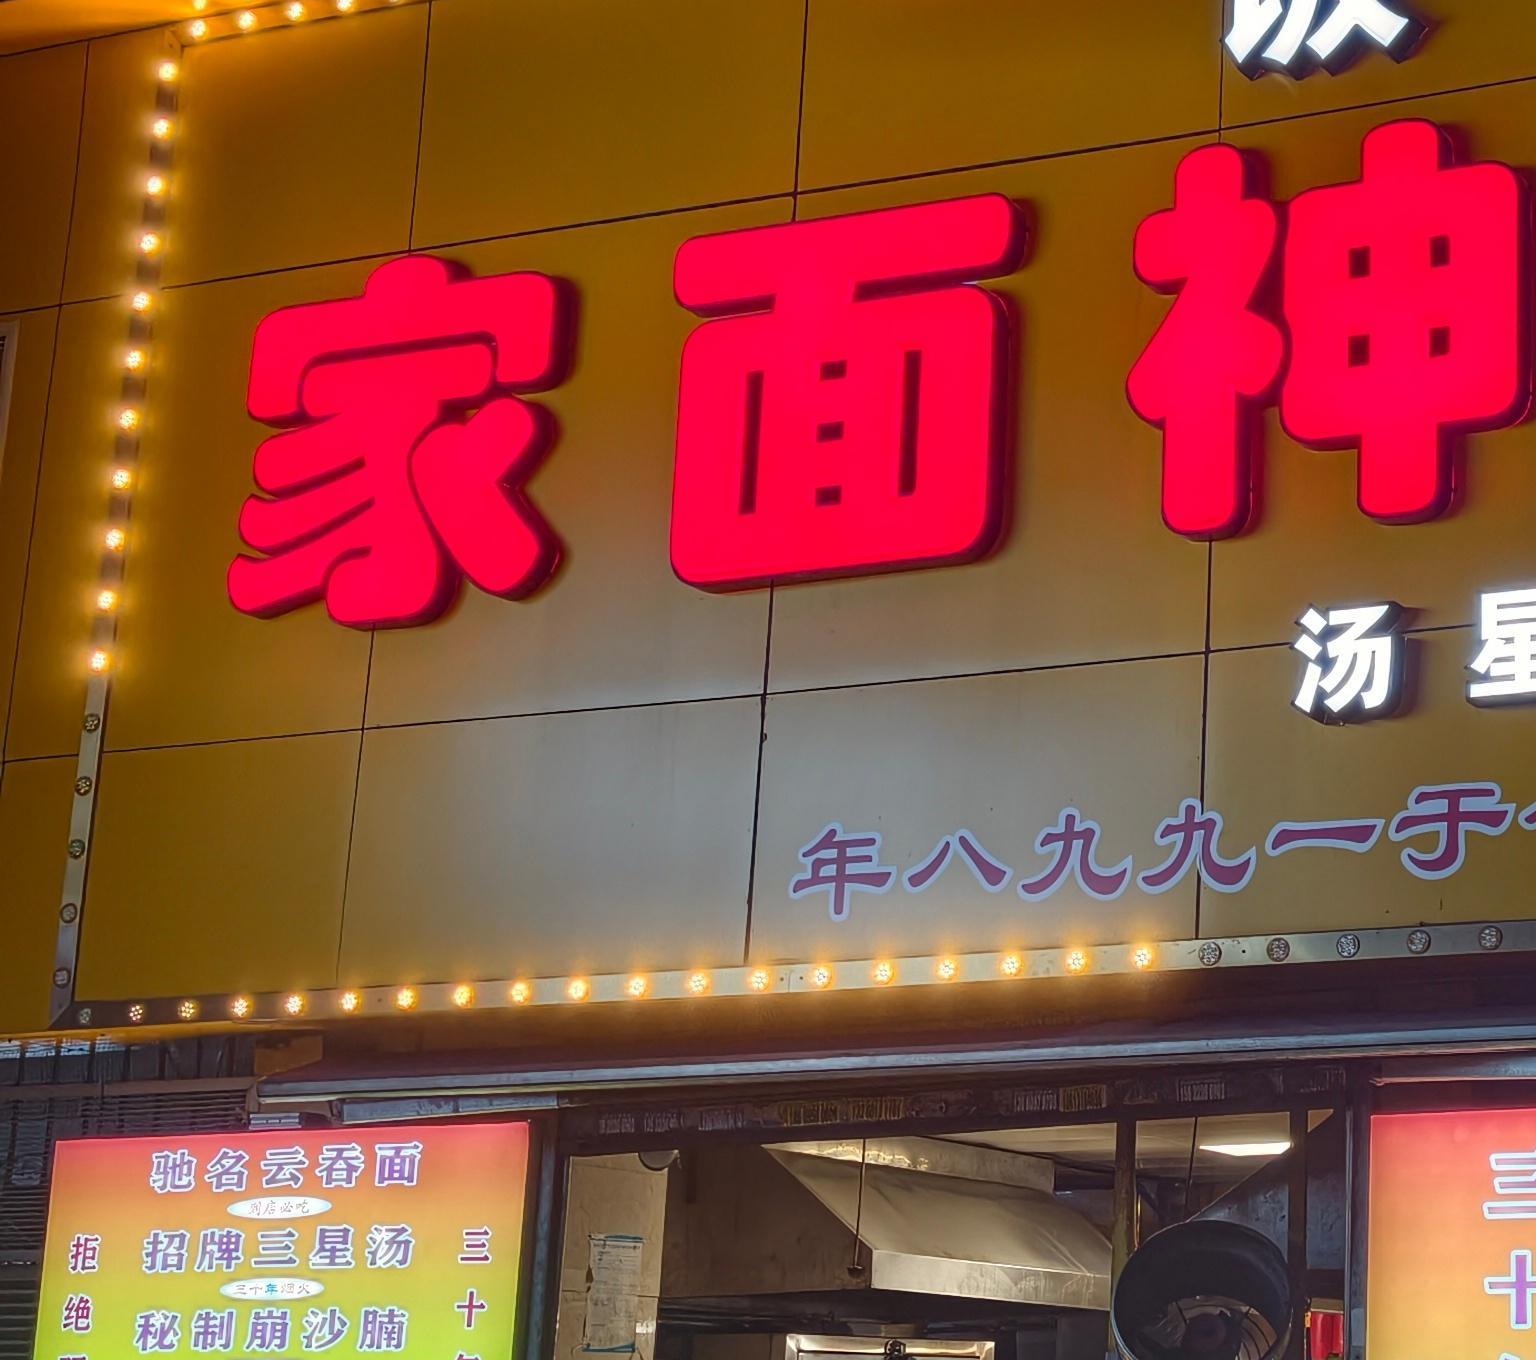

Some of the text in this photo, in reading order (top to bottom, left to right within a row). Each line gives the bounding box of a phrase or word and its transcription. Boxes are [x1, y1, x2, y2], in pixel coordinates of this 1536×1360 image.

[150, 1141, 424, 1193] 驰名云吞面
[142, 1224, 415, 1274] 招牌三星汤
[135, 1307, 408, 1352] 秘制崩沙腩
